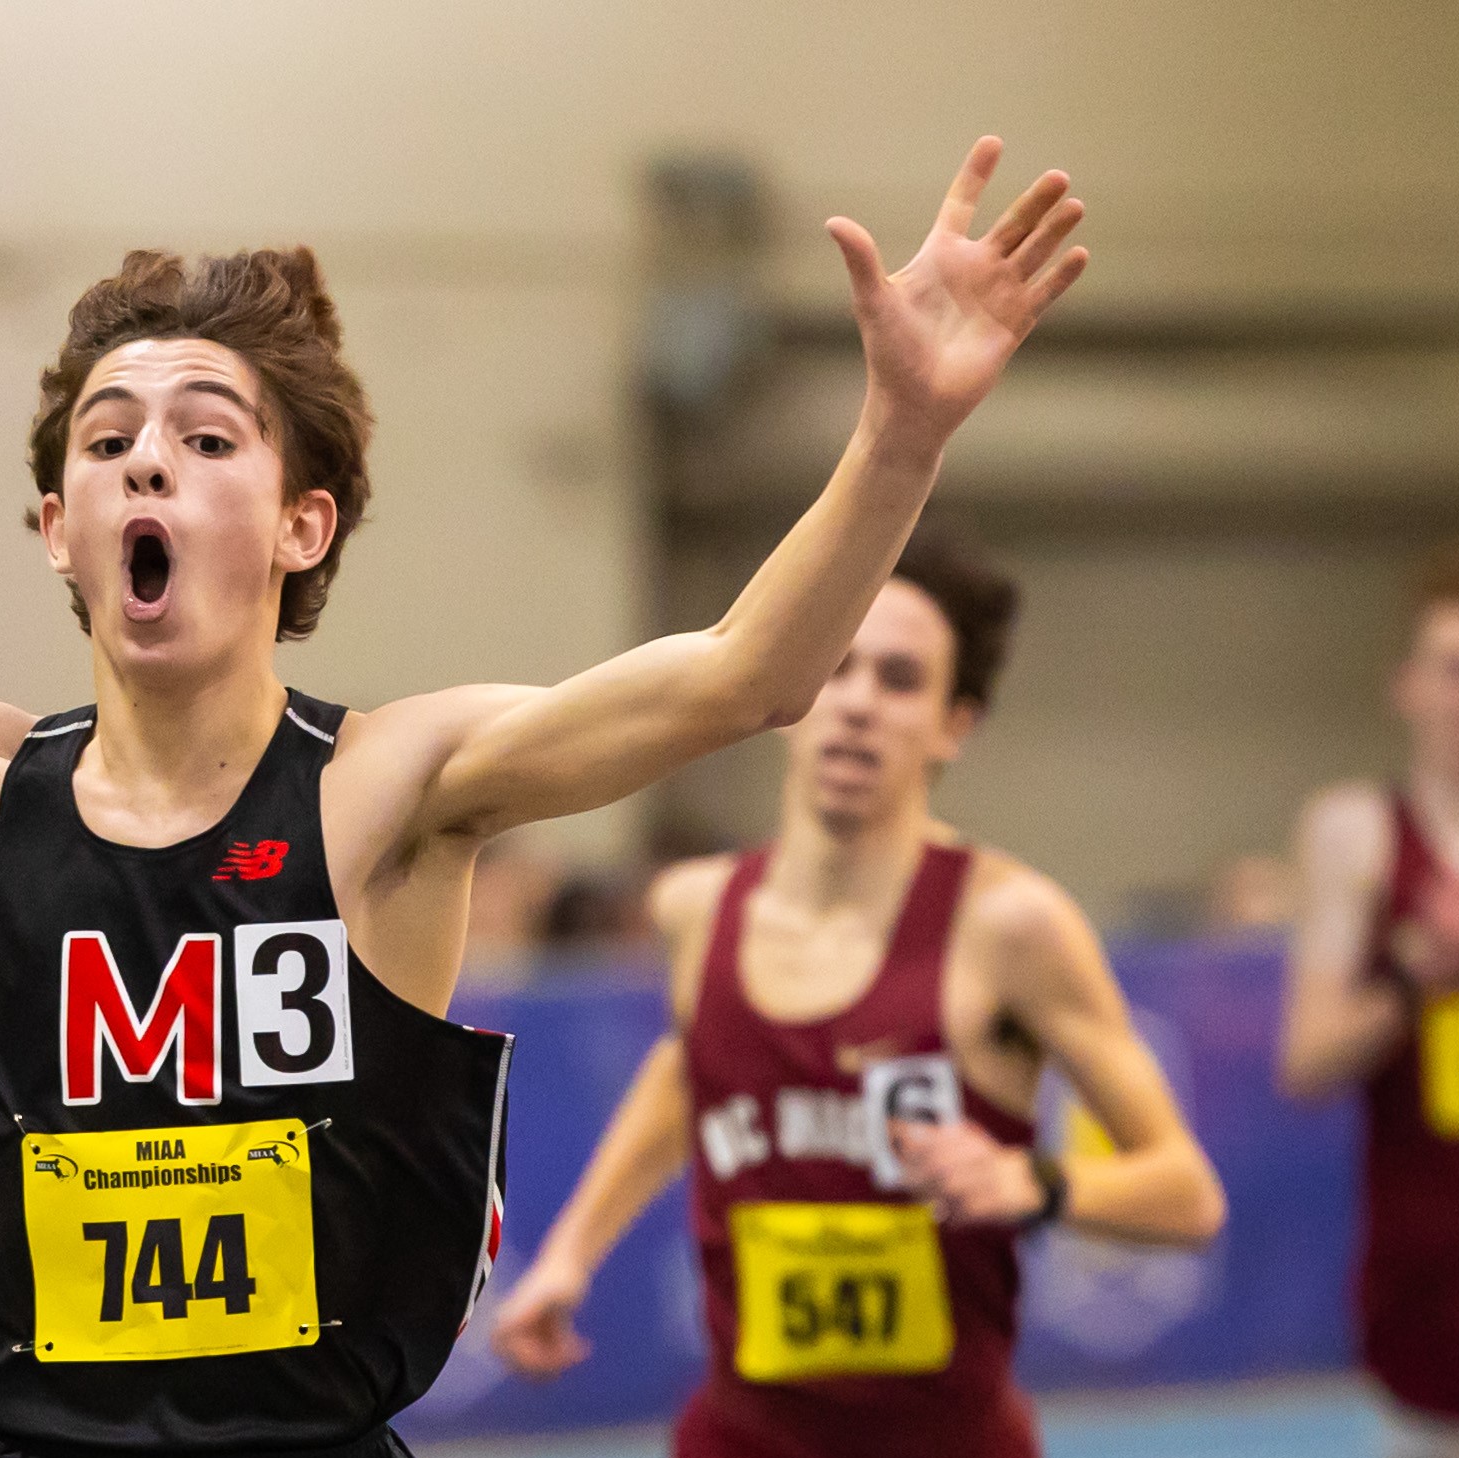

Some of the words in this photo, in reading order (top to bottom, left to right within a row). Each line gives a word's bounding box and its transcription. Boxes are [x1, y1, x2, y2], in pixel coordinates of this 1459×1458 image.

[61, 931, 222, 1106] M
[252, 932, 336, 1074] 3
[83, 1162, 242, 1190] Championships
[136, 1139, 186, 1162] MIAA
[82, 1213, 256, 1322] 744
[776, 1271, 902, 1347] 547
